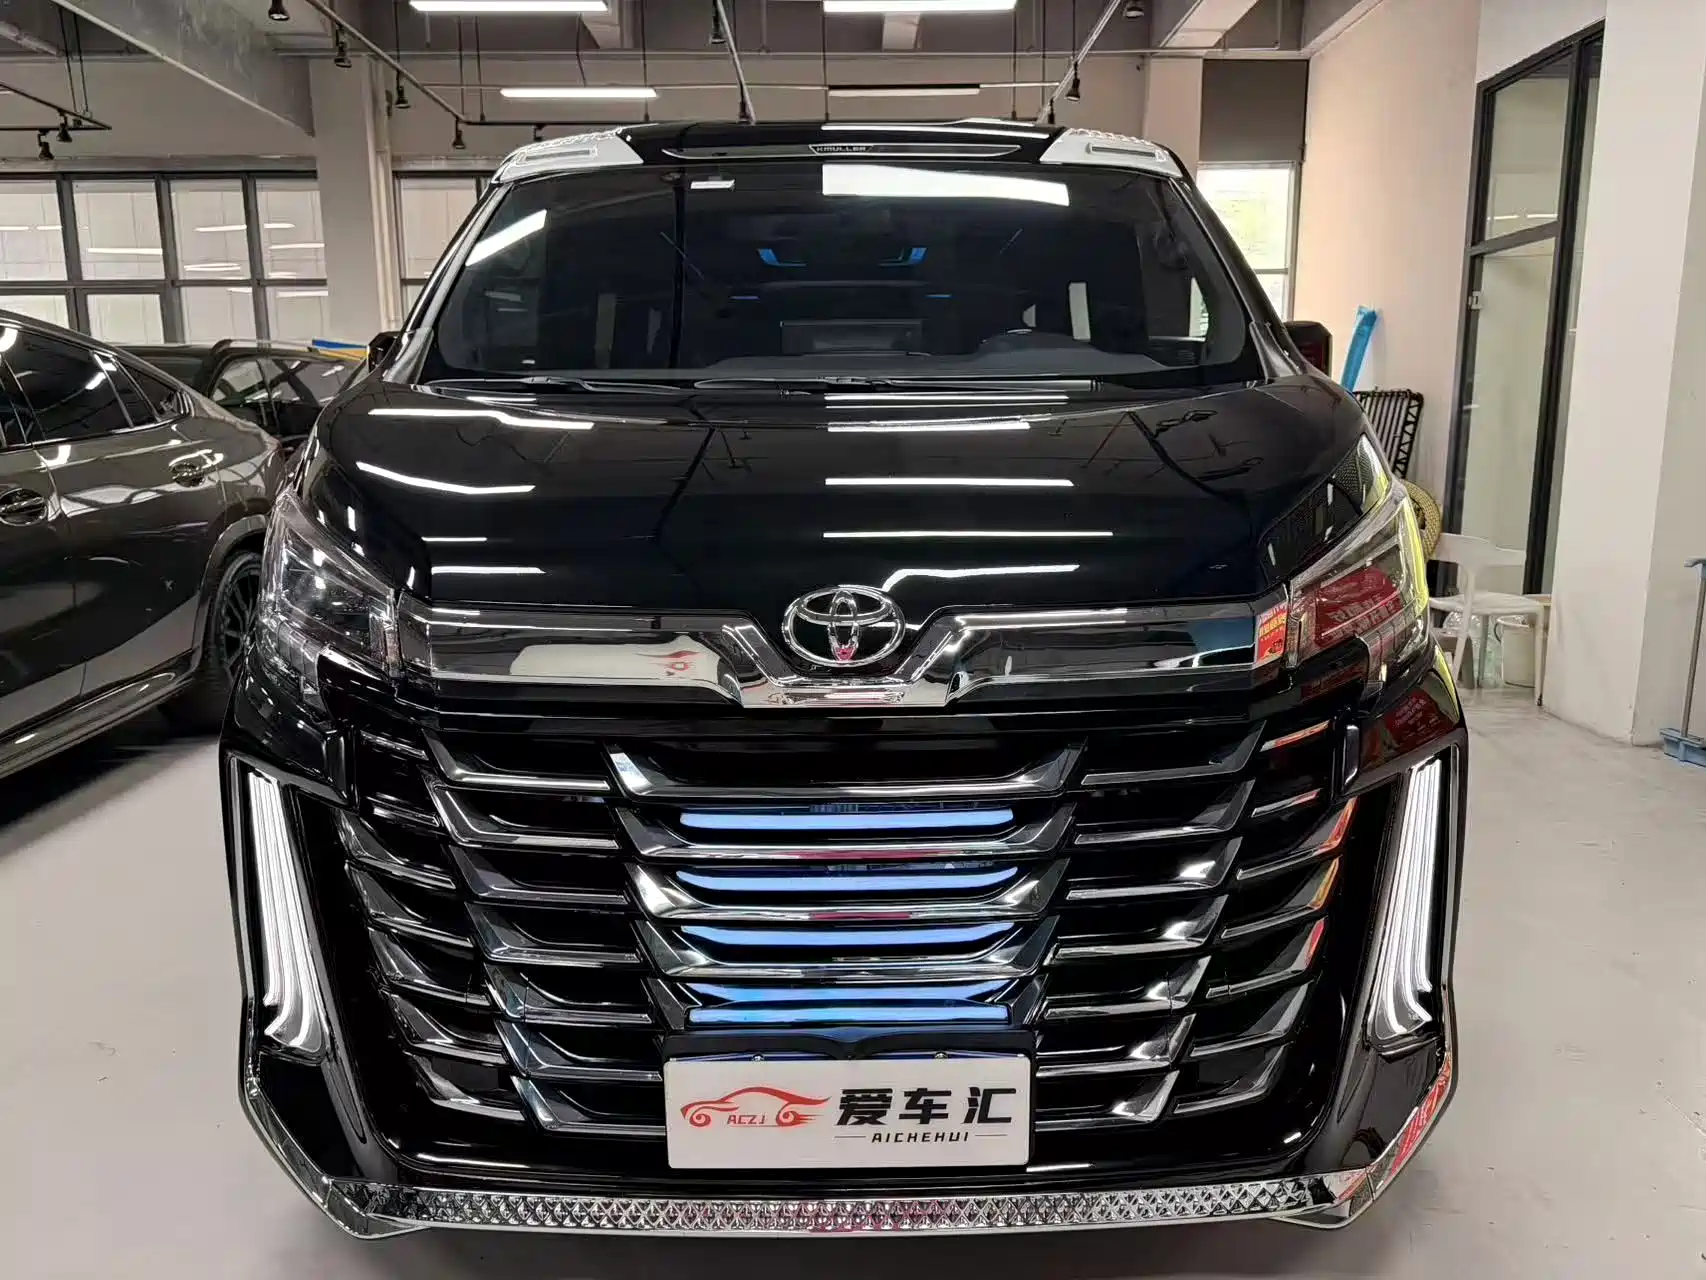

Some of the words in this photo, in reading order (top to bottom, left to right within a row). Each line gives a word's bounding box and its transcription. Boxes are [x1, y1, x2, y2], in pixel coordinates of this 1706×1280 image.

[835, 1087, 1017, 1126] 爱车汇
[727, 1113, 767, 1126] ACZJ
[871, 1131, 970, 1144] AICHEHUI
